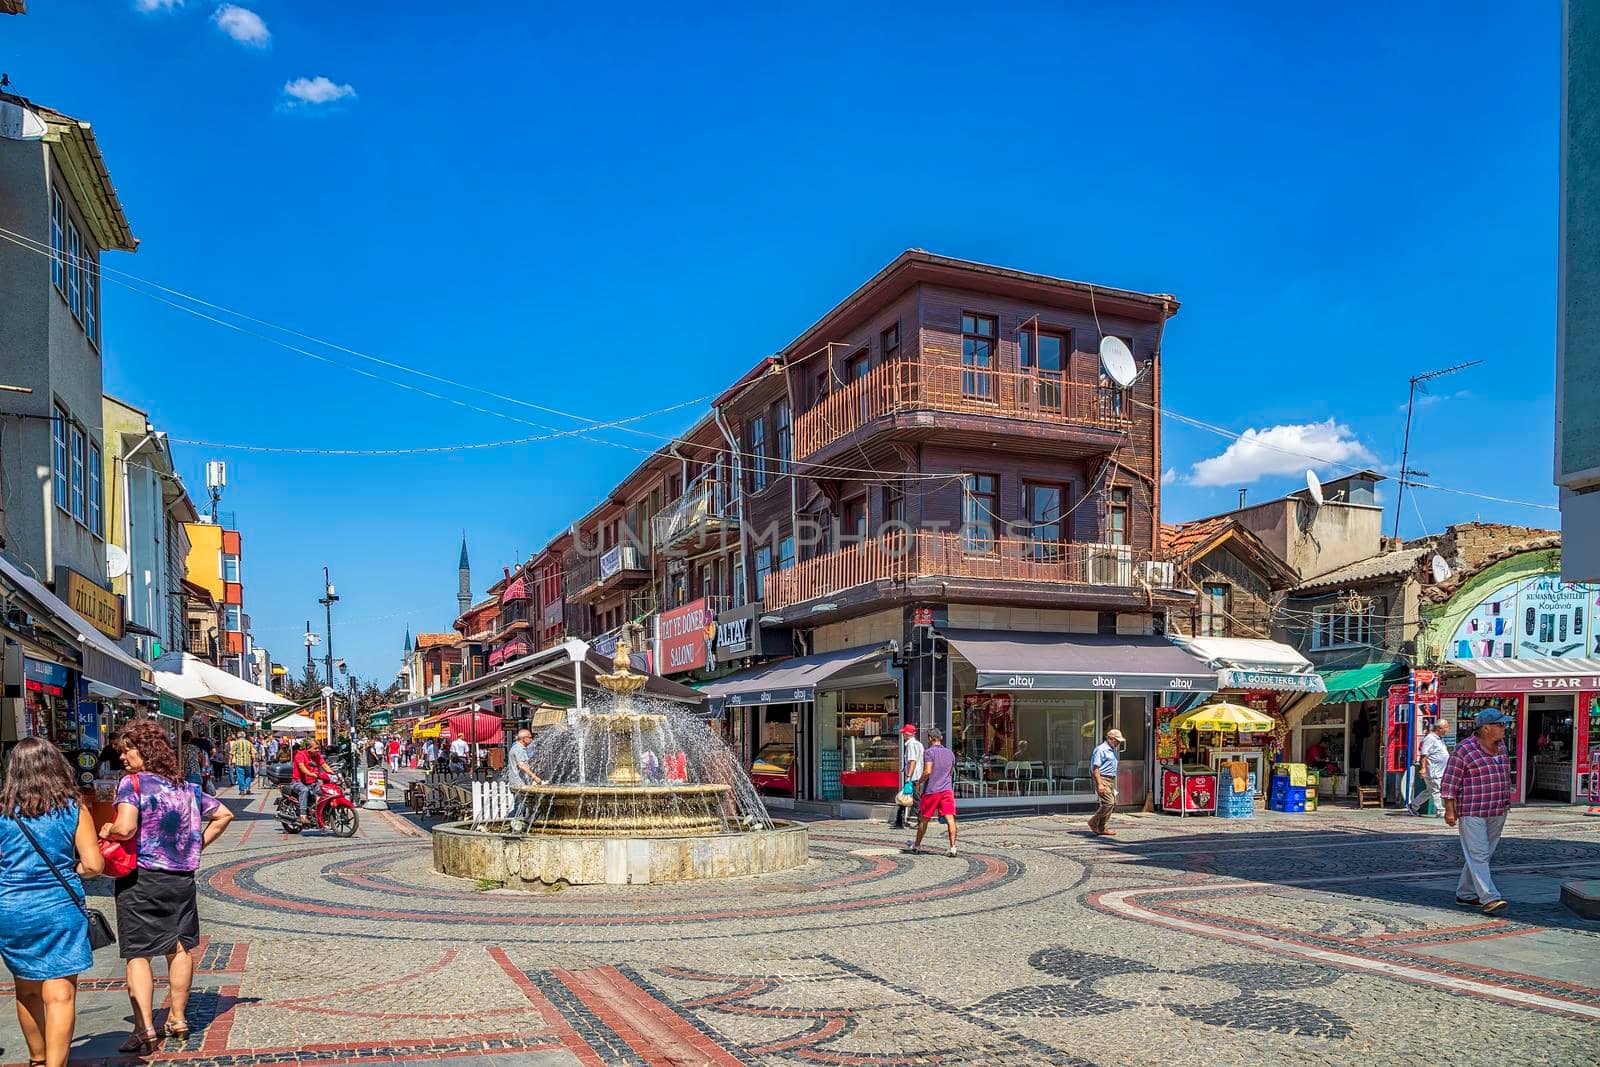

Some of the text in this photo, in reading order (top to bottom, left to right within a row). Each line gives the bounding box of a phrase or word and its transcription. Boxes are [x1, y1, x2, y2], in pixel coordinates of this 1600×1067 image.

[682, 608, 704, 634] DÖNER
[717, 618, 747, 647] ALTAY
[1008, 675, 1034, 689] altay
[1092, 675, 1116, 689] altay
[1169, 677, 1193, 689] altay
[1248, 674, 1296, 685] GÖZDE TEKEL
[1532, 678, 1581, 688] STAR
